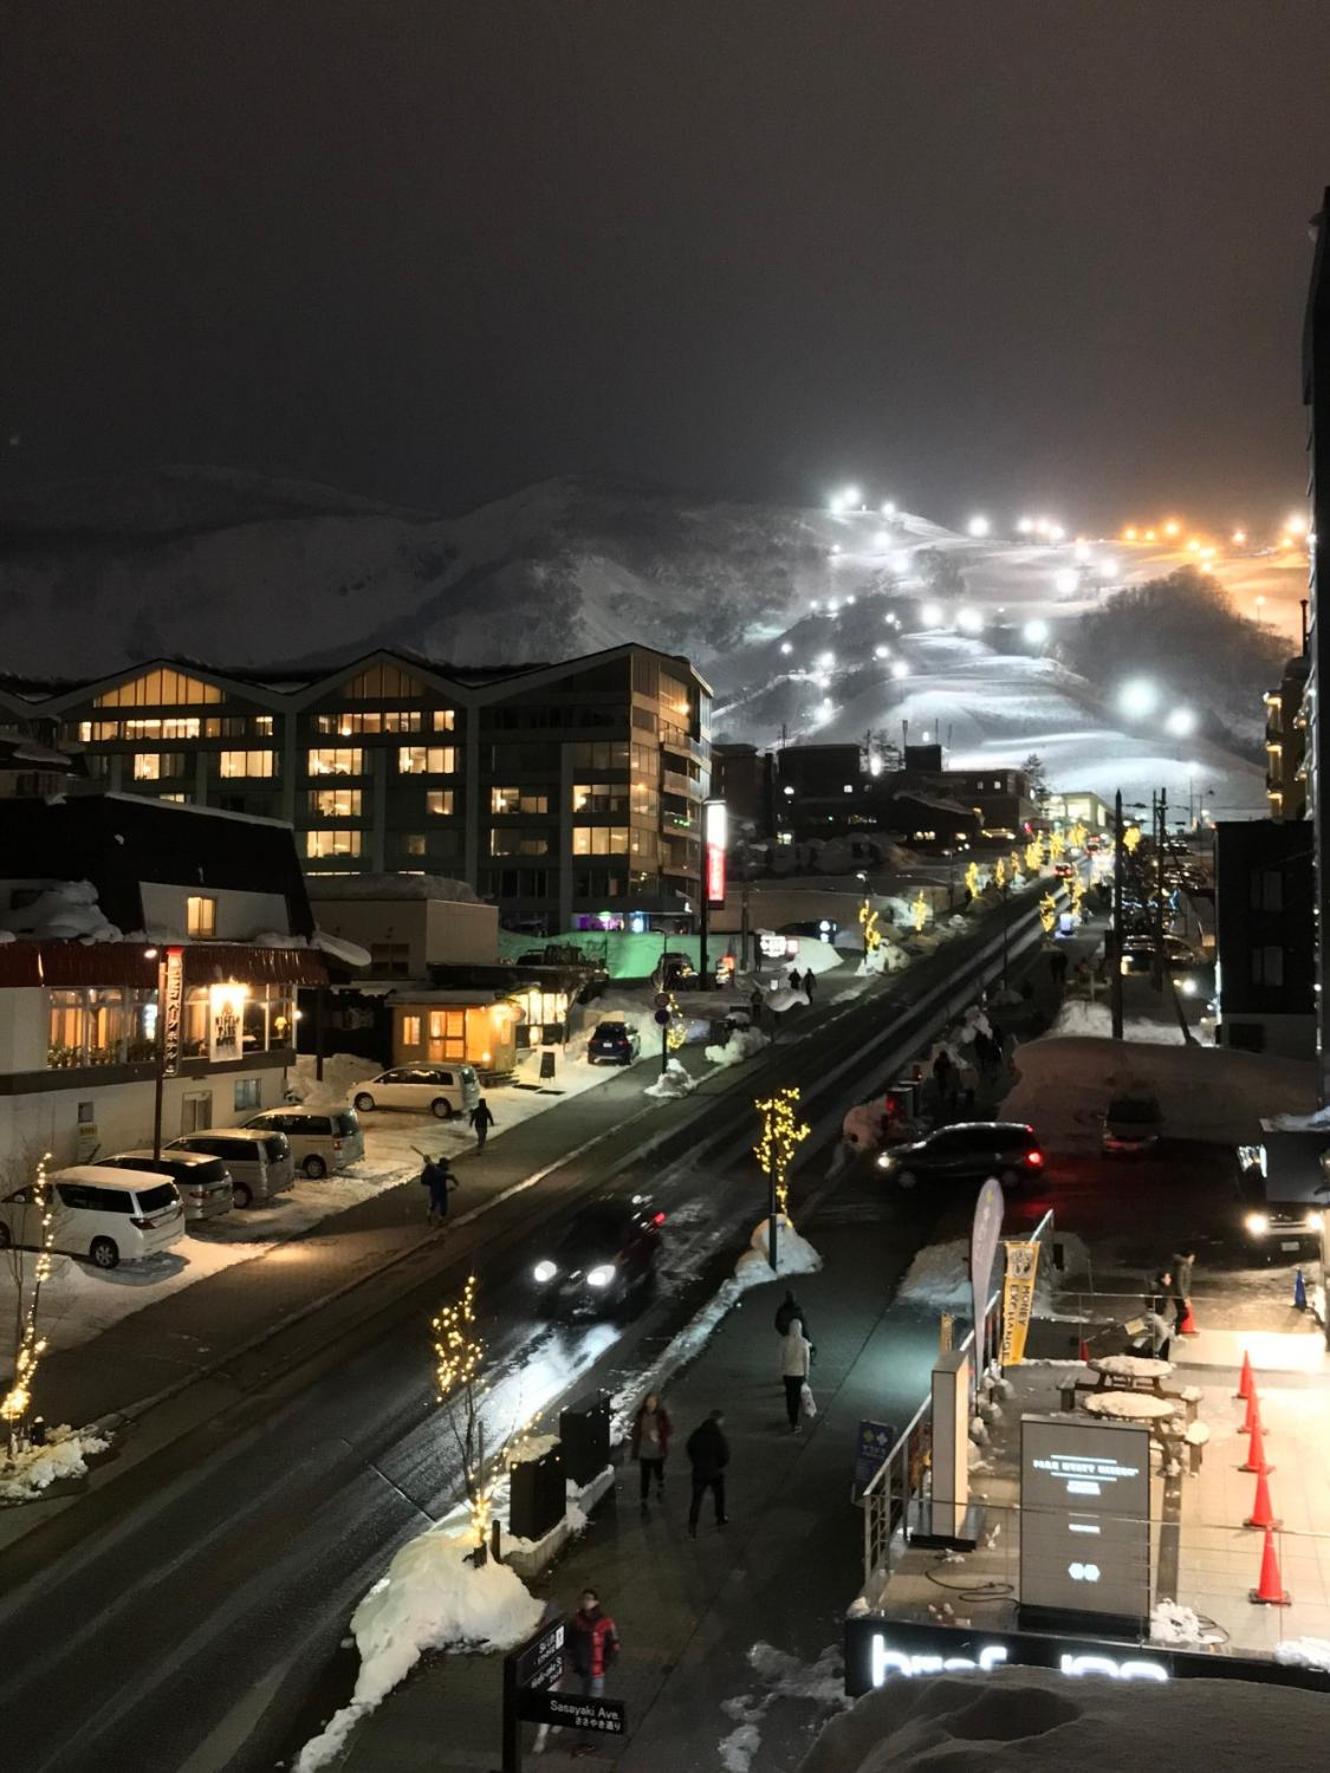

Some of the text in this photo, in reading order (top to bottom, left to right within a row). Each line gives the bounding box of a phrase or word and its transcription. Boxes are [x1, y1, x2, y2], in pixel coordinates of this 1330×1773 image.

[1002, 1284, 1019, 1357] EXCHANGE
[1018, 1286, 1031, 1326] MONEY
[550, 1700, 595, 1716] Sasayaki
